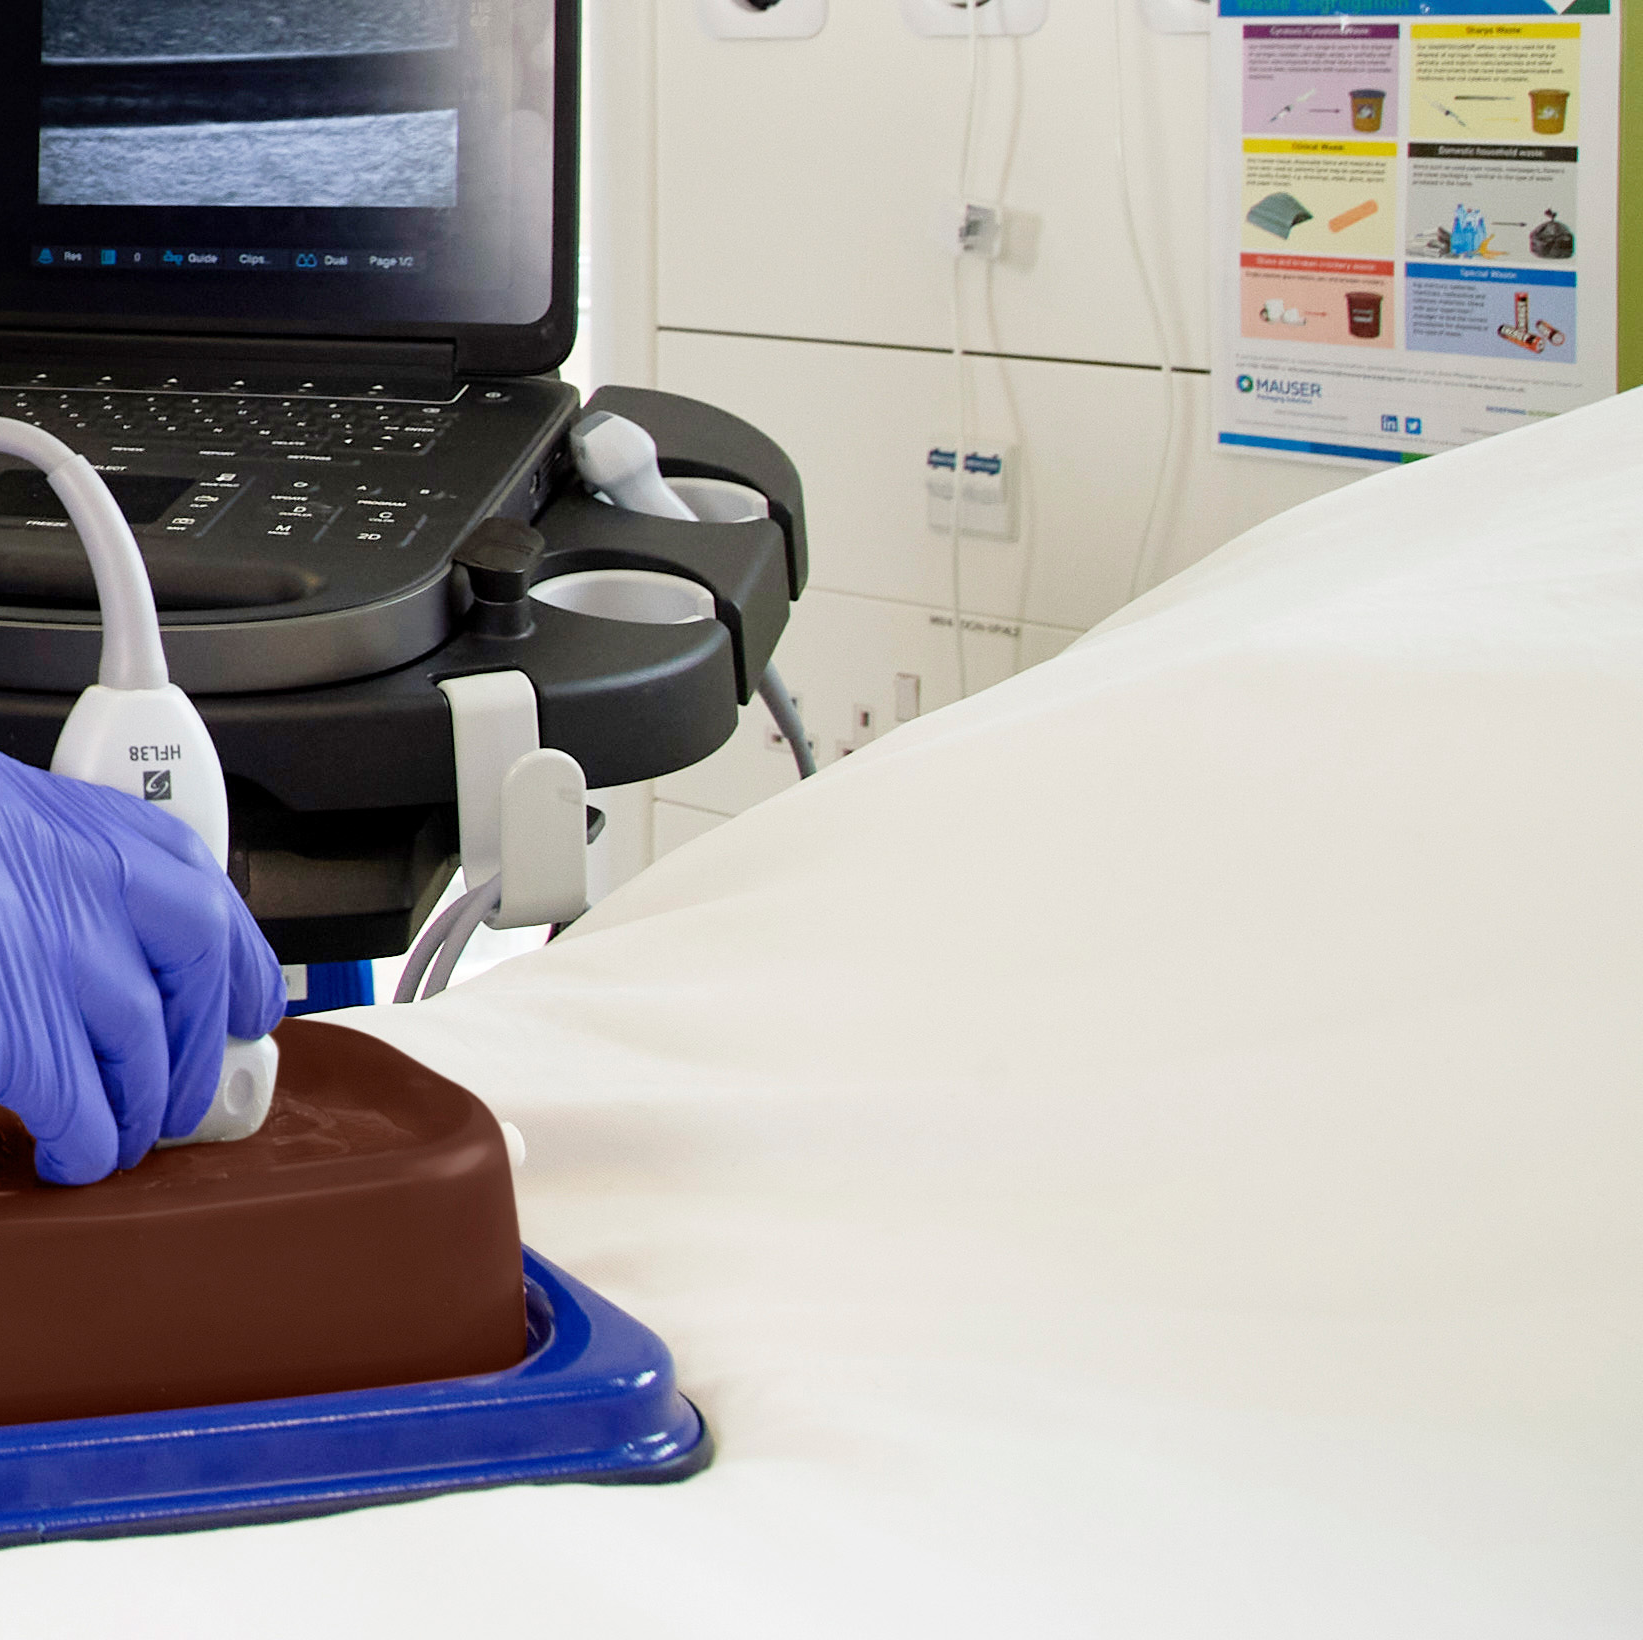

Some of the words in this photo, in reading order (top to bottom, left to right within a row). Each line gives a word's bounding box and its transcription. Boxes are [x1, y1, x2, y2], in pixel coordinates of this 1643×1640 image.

[188, 253, 217, 264] Guide
[324, 255, 348, 265] Dual
[369, 256, 397, 269] Page
[1256, 378, 1323, 398] MAUSER
[270, 494, 309, 502] UPDATE
[356, 499, 408, 508] PROGRAM
[25, 520, 69, 528] FREEZE
[356, 532, 382, 541] 2D
[129, 744, 181, 761] HFL38
